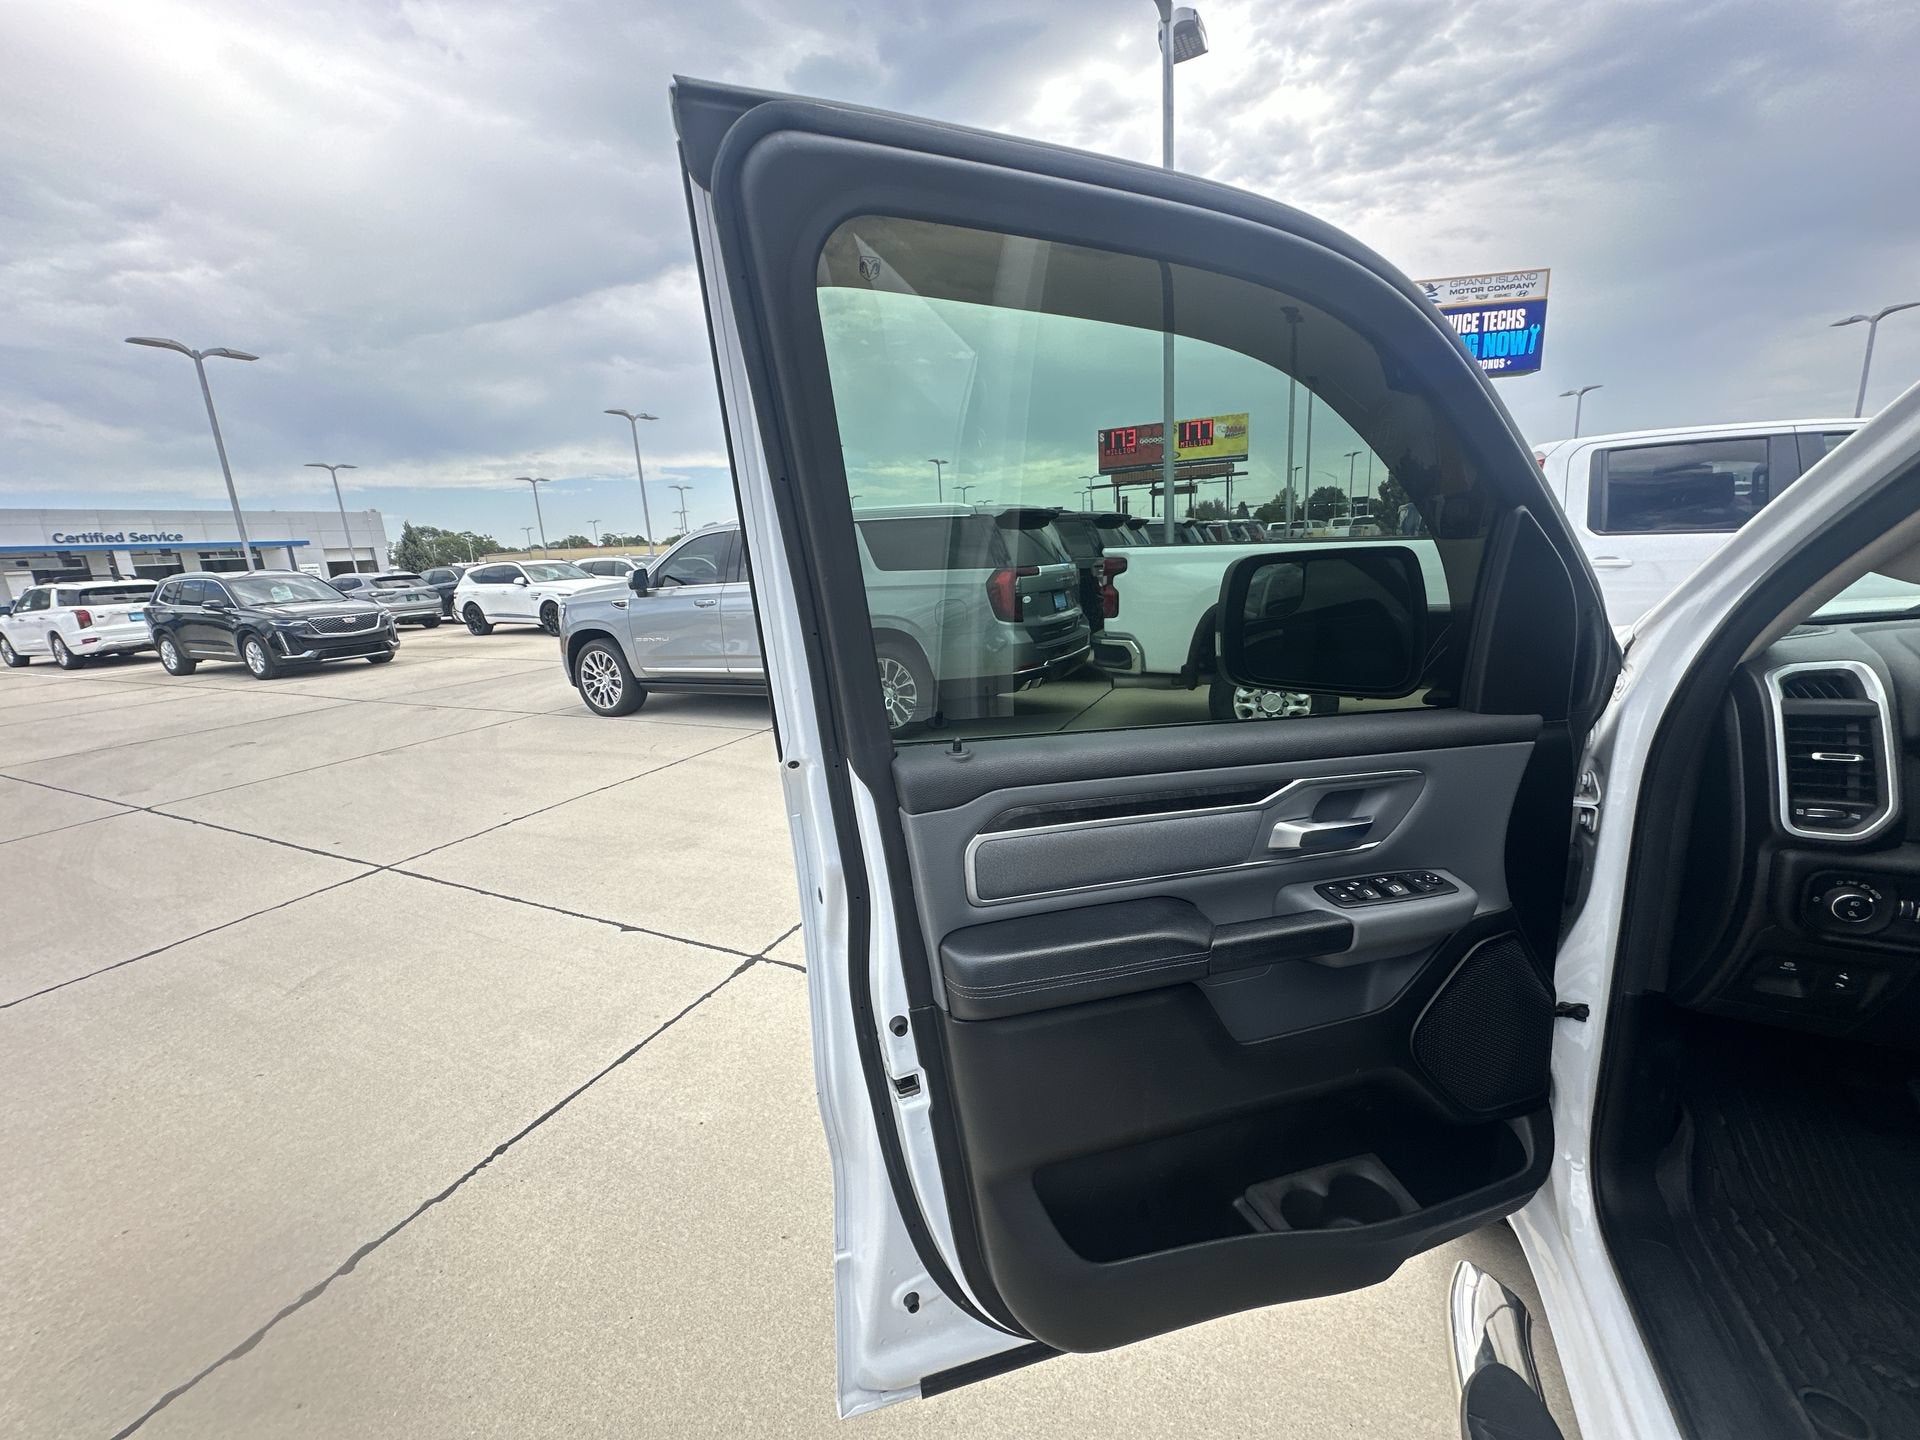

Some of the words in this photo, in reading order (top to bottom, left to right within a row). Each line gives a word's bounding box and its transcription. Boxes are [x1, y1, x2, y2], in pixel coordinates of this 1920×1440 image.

[1449, 286, 1484, 296] MOTOR
[1487, 281, 1537, 292] COMPANY
[1450, 278, 1492, 288] GRAND
[1495, 273, 1538, 284] ISLAND
[1482, 308, 1526, 332] TECHS
[1482, 329, 1529, 358] NOW
[1111, 428, 1137, 449] 173
[1185, 419, 1213, 441] 177
[52, 531, 125, 544] Certified
[128, 531, 183, 543] Service
